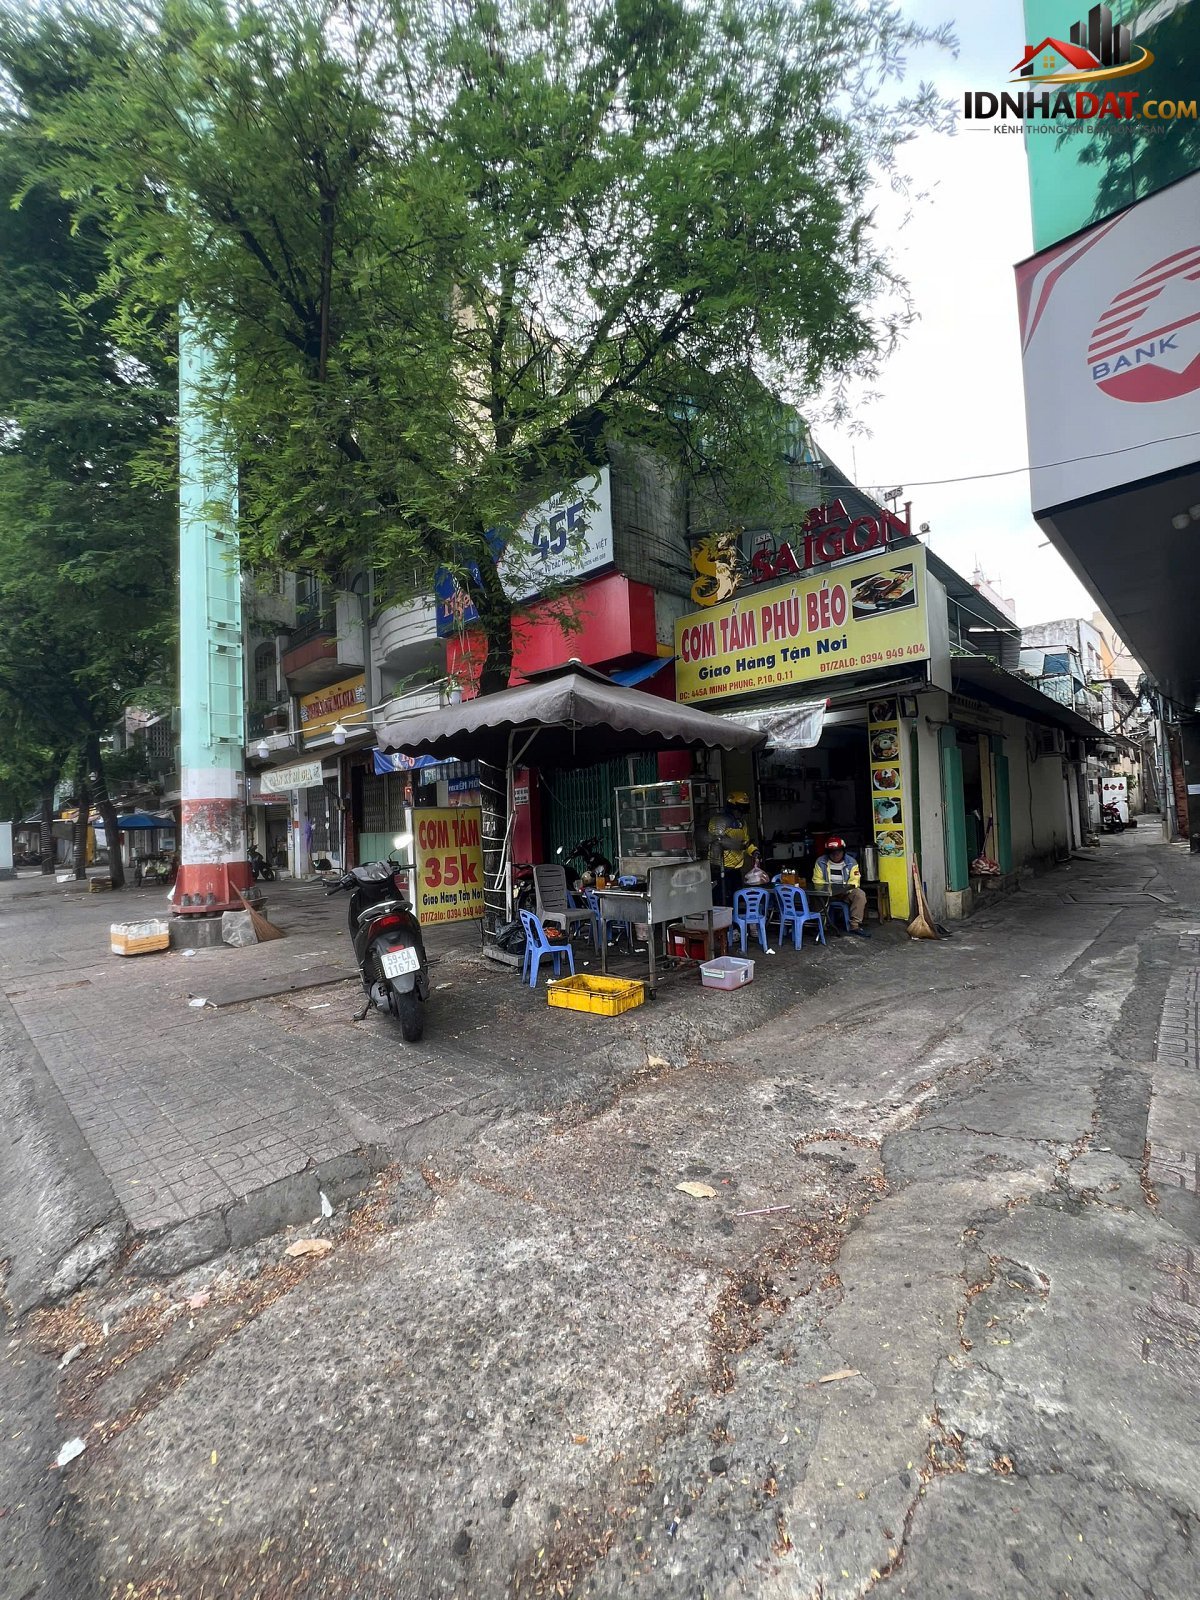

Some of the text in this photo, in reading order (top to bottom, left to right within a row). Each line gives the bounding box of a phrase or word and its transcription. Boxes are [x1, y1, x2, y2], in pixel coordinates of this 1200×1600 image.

[1092, 333, 1179, 380] BANK
[532, 499, 586, 561] 455
[752, 501, 912, 584] SAIGON
[720, 602, 756, 652] TẤM
[761, 588, 800, 643] PHÚ
[806, 579, 847, 632] BÉO
[699, 634, 848, 680] Giao Hàng Tận Nơi
[820, 643, 926, 673] ĐT/ZALO: 0394 949 404
[709, 684, 728, 695] MINH
[729, 678, 756, 692] PHỤNG,
[757, 674, 775, 686] P.10,
[777, 670, 794, 681] Q.11
[419, 810, 480, 850] CƠM TẤM
[425, 853, 478, 888] 35k
[421, 909, 446, 923] ĐT/Zalo:
[447, 908, 460, 920] 0394
[463, 905, 474, 916] 949
[423, 893, 438, 905] Giao
[440, 892, 457, 905] Hàng
